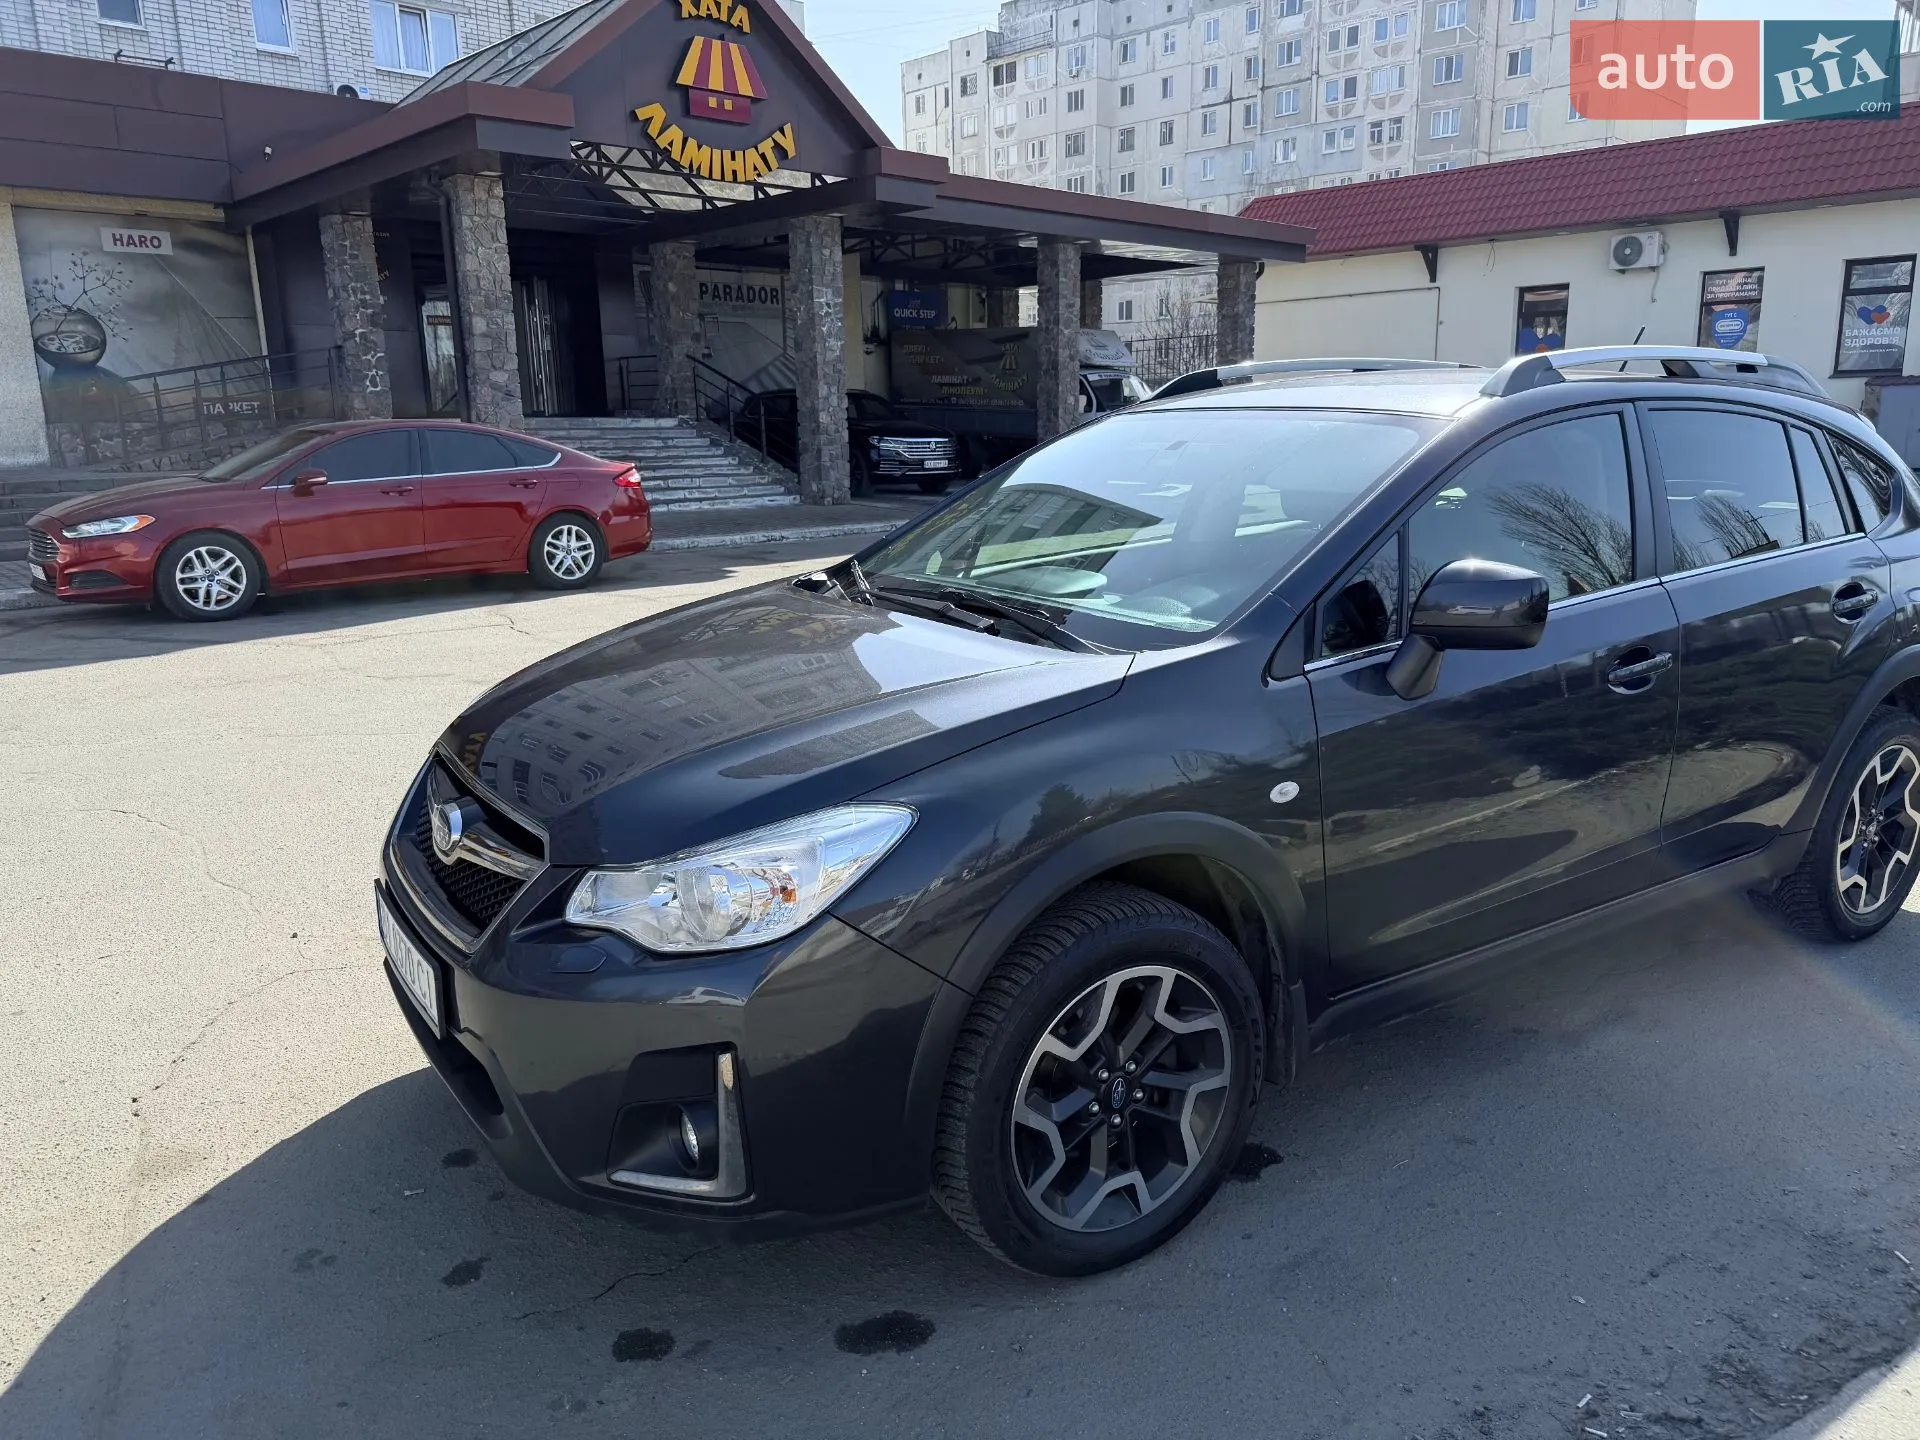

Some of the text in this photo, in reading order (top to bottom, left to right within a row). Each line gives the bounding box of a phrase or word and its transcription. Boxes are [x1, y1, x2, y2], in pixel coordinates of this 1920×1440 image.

[679, 0, 751, 33] ХАТА
[634, 102, 797, 183] ЛАМІНАТУ
[111, 232, 162, 249] HARO
[699, 282, 780, 306] PARADOR
[894, 308, 936, 318] QUICK STEP
[1845, 326, 1900, 336] БАЖАЄМО
[1844, 336, 1900, 347] ЗДОРОВ'Я
[932, 375, 968, 384] ЛАМІНАТ
